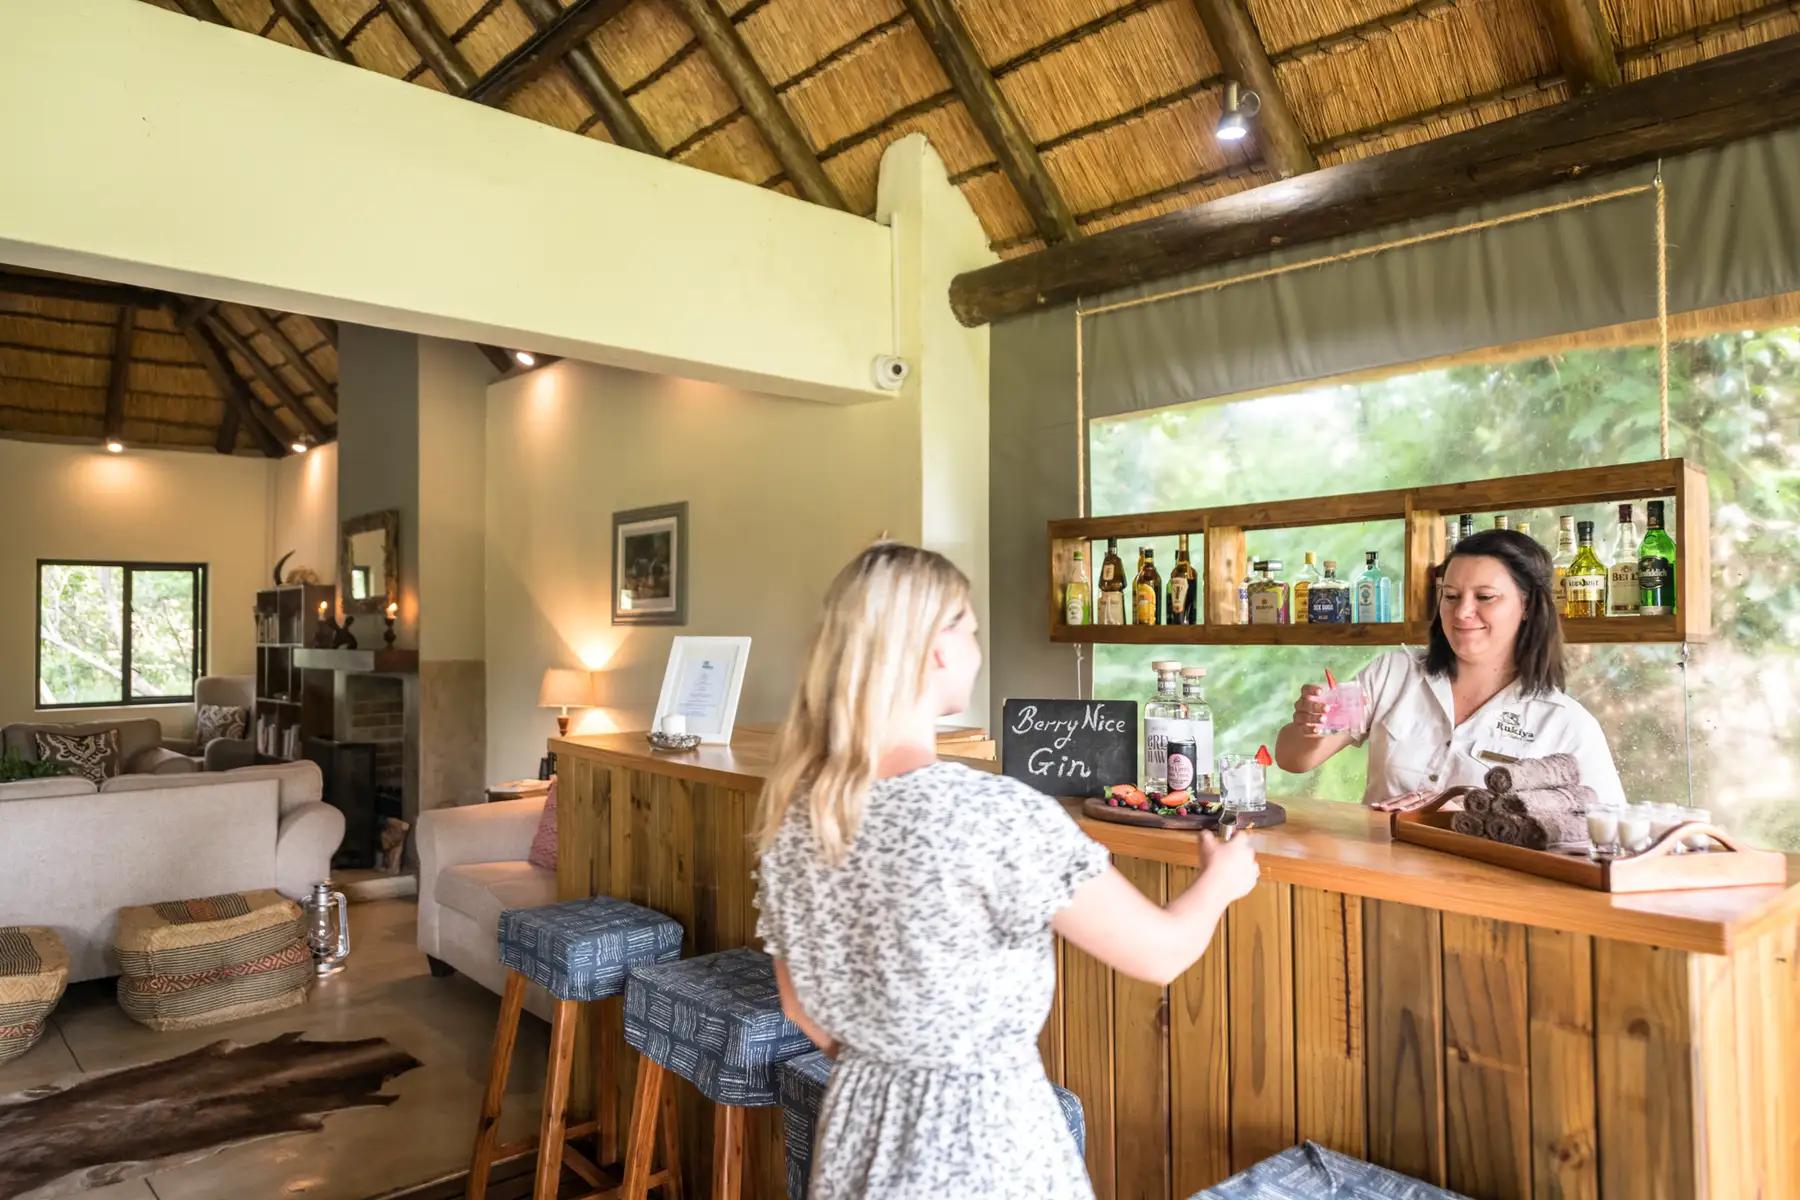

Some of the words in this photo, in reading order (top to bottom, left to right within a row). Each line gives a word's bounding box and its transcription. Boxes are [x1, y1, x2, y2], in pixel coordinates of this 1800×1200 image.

[1011, 705, 1079, 749] Berry
[1081, 703, 1125, 732] Nice
[1496, 721, 1534, 738] Rukiya
[1027, 747, 1092, 778] Gin
